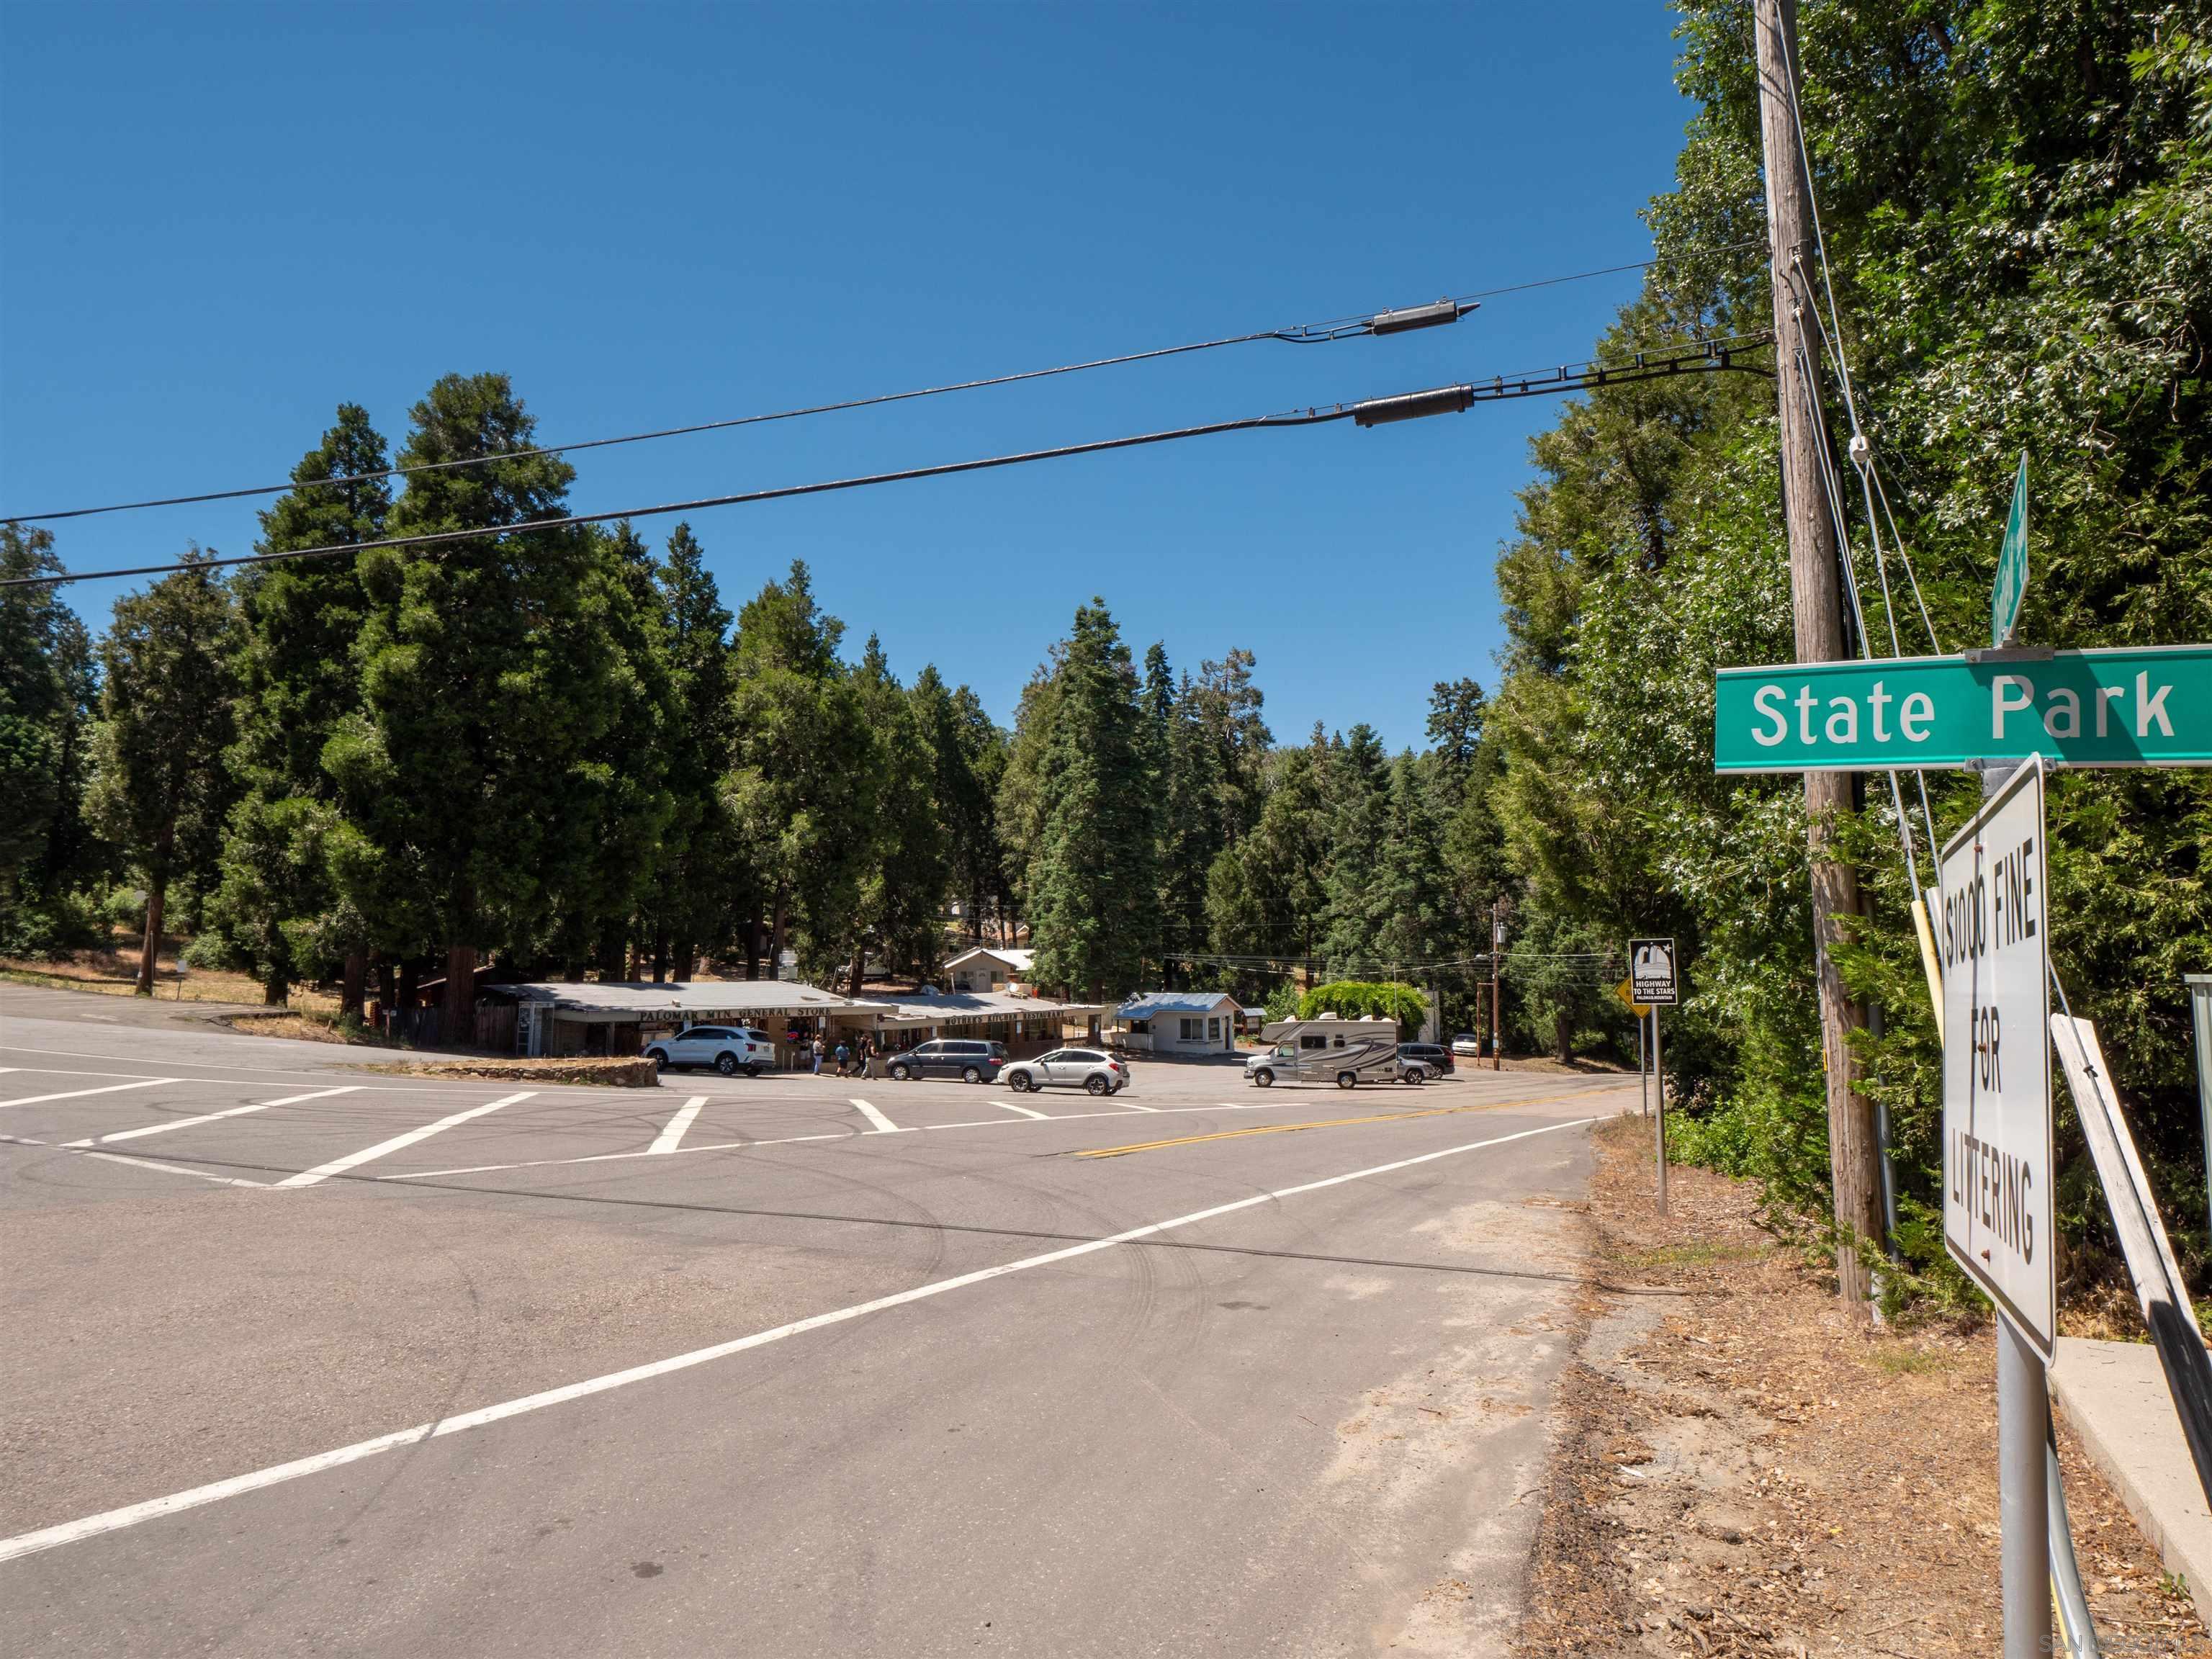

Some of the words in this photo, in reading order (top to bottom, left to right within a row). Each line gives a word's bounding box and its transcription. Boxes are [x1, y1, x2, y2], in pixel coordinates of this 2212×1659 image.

[1751, 680, 1935, 747] State
[1992, 670, 2175, 739] Park
[1946, 873, 1987, 975] $1000
[1995, 837, 2036, 949] FINE
[640, 1010, 698, 1021] PALOMAR
[739, 1008, 791, 1017] GENERAL
[797, 1007, 832, 1016] STORE
[987, 1012, 1018, 1022] KITCHEN
[1023, 1010, 1066, 1020] RESTAURANT
[1970, 1006, 2002, 1093] FOR
[1952, 1127, 2033, 1267] LITTERING
